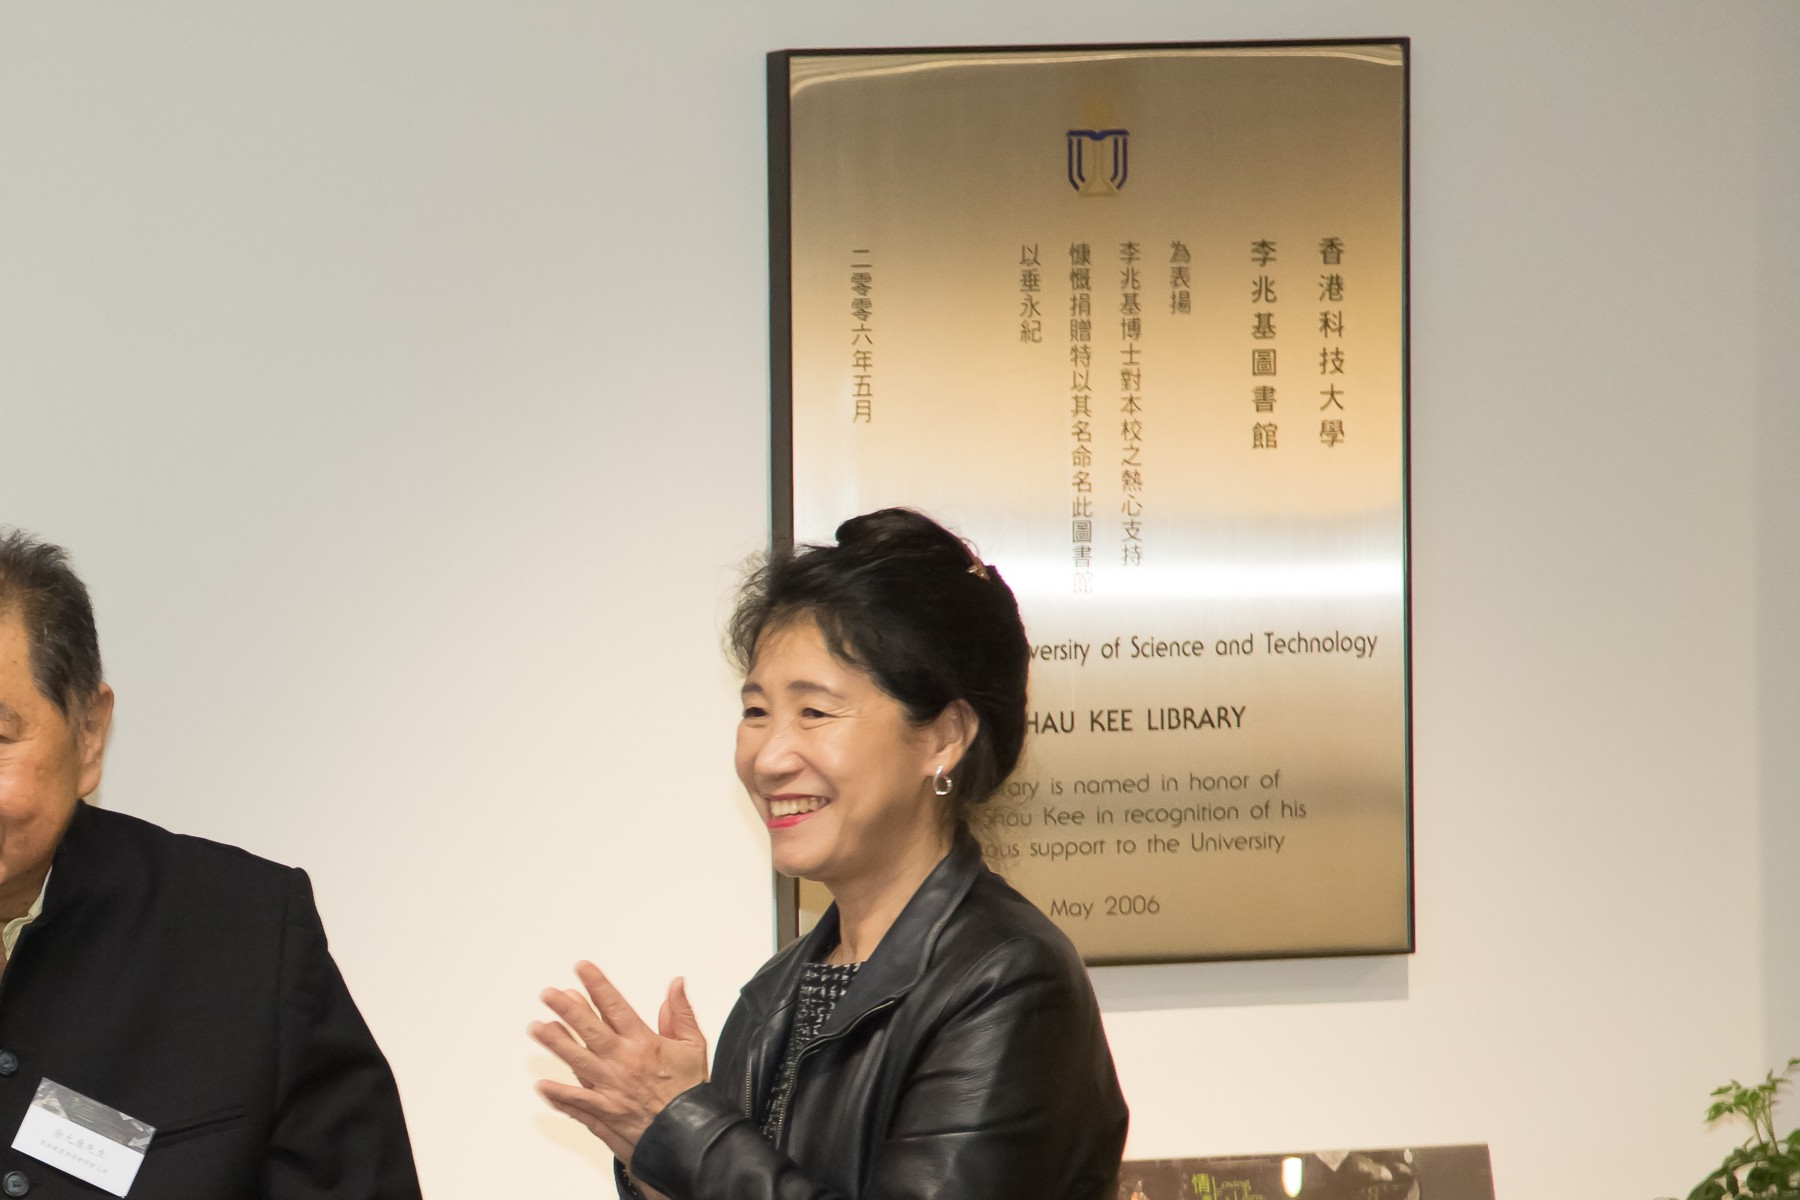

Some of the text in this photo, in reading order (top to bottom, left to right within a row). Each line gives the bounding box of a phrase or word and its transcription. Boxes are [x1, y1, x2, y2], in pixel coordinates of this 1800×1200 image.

[1020, 244, 1042, 343] 以垂永紀
[851, 250, 873, 423] 二零零六年五月
[1252, 239, 1278, 449] 李兆基圖書館
[1319, 237, 1344, 447] 香港科技大學
[1120, 241, 1142, 565] 李兆基博士對本校之熱心支持
[1101, 635, 1121, 660] of
[1131, 634, 1204, 660] Science
[1216, 631, 1254, 657] and
[1264, 630, 1378, 660] Technology
[1090, 709, 1133, 734] KEE
[1148, 705, 1246, 732] LIBRARY
[1051, 777, 1063, 795] is
[1074, 773, 1149, 795] named
[1162, 772, 1178, 792] in
[1190, 771, 1249, 791] honor
[1260, 768, 1281, 789] of
[1044, 806, 1084, 826] Kee
[1097, 806, 1113, 825] in
[1125, 802, 1238, 827] recognition
[1250, 799, 1270, 819] of
[1281, 799, 1306, 819] his
[1030, 840, 1105, 861] support
[1117, 837, 1136, 854] to
[1148, 834, 1179, 854] the
[1191, 832, 1285, 854] University
[1050, 895, 1160, 921] May 2006
